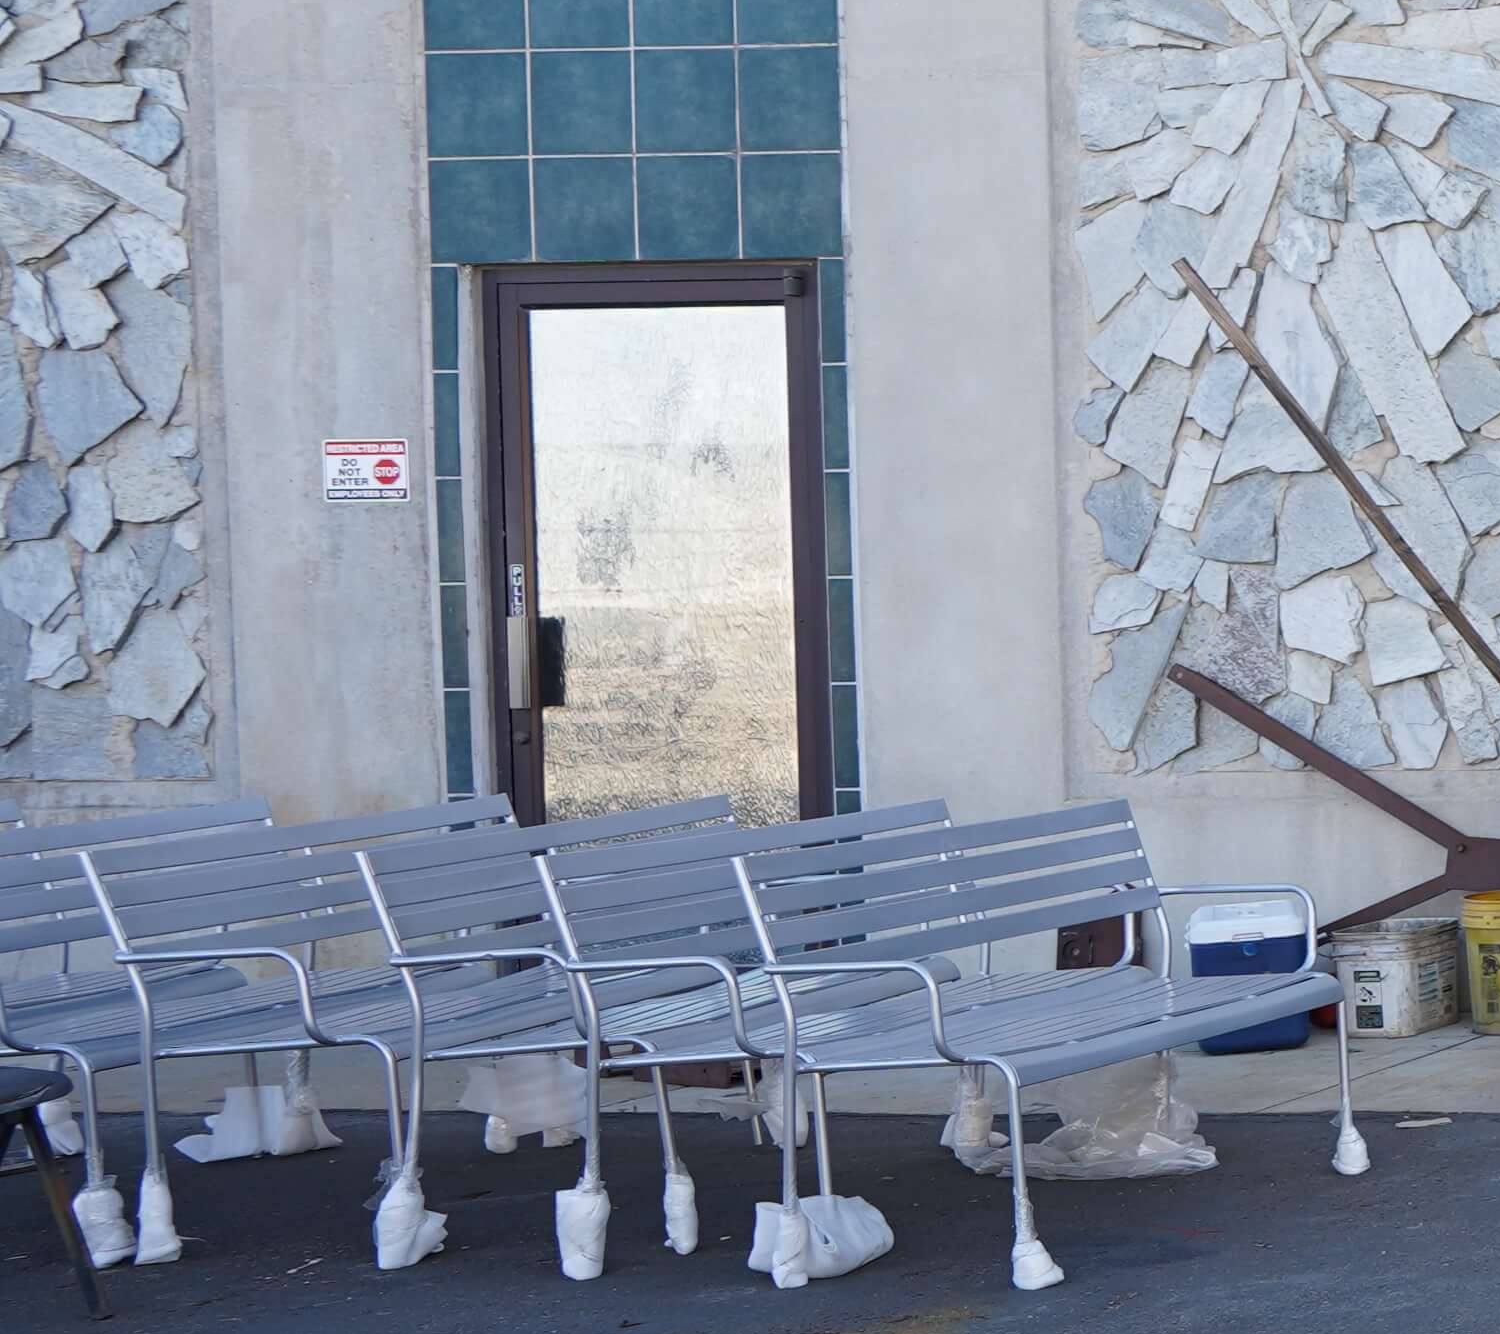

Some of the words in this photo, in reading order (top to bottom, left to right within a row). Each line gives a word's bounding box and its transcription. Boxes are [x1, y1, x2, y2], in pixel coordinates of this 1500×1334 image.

[341, 458, 358, 467] DO
[338, 468, 361, 477] NOT
[331, 477, 369, 487] ENTER
[512, 566, 523, 606] PULL
